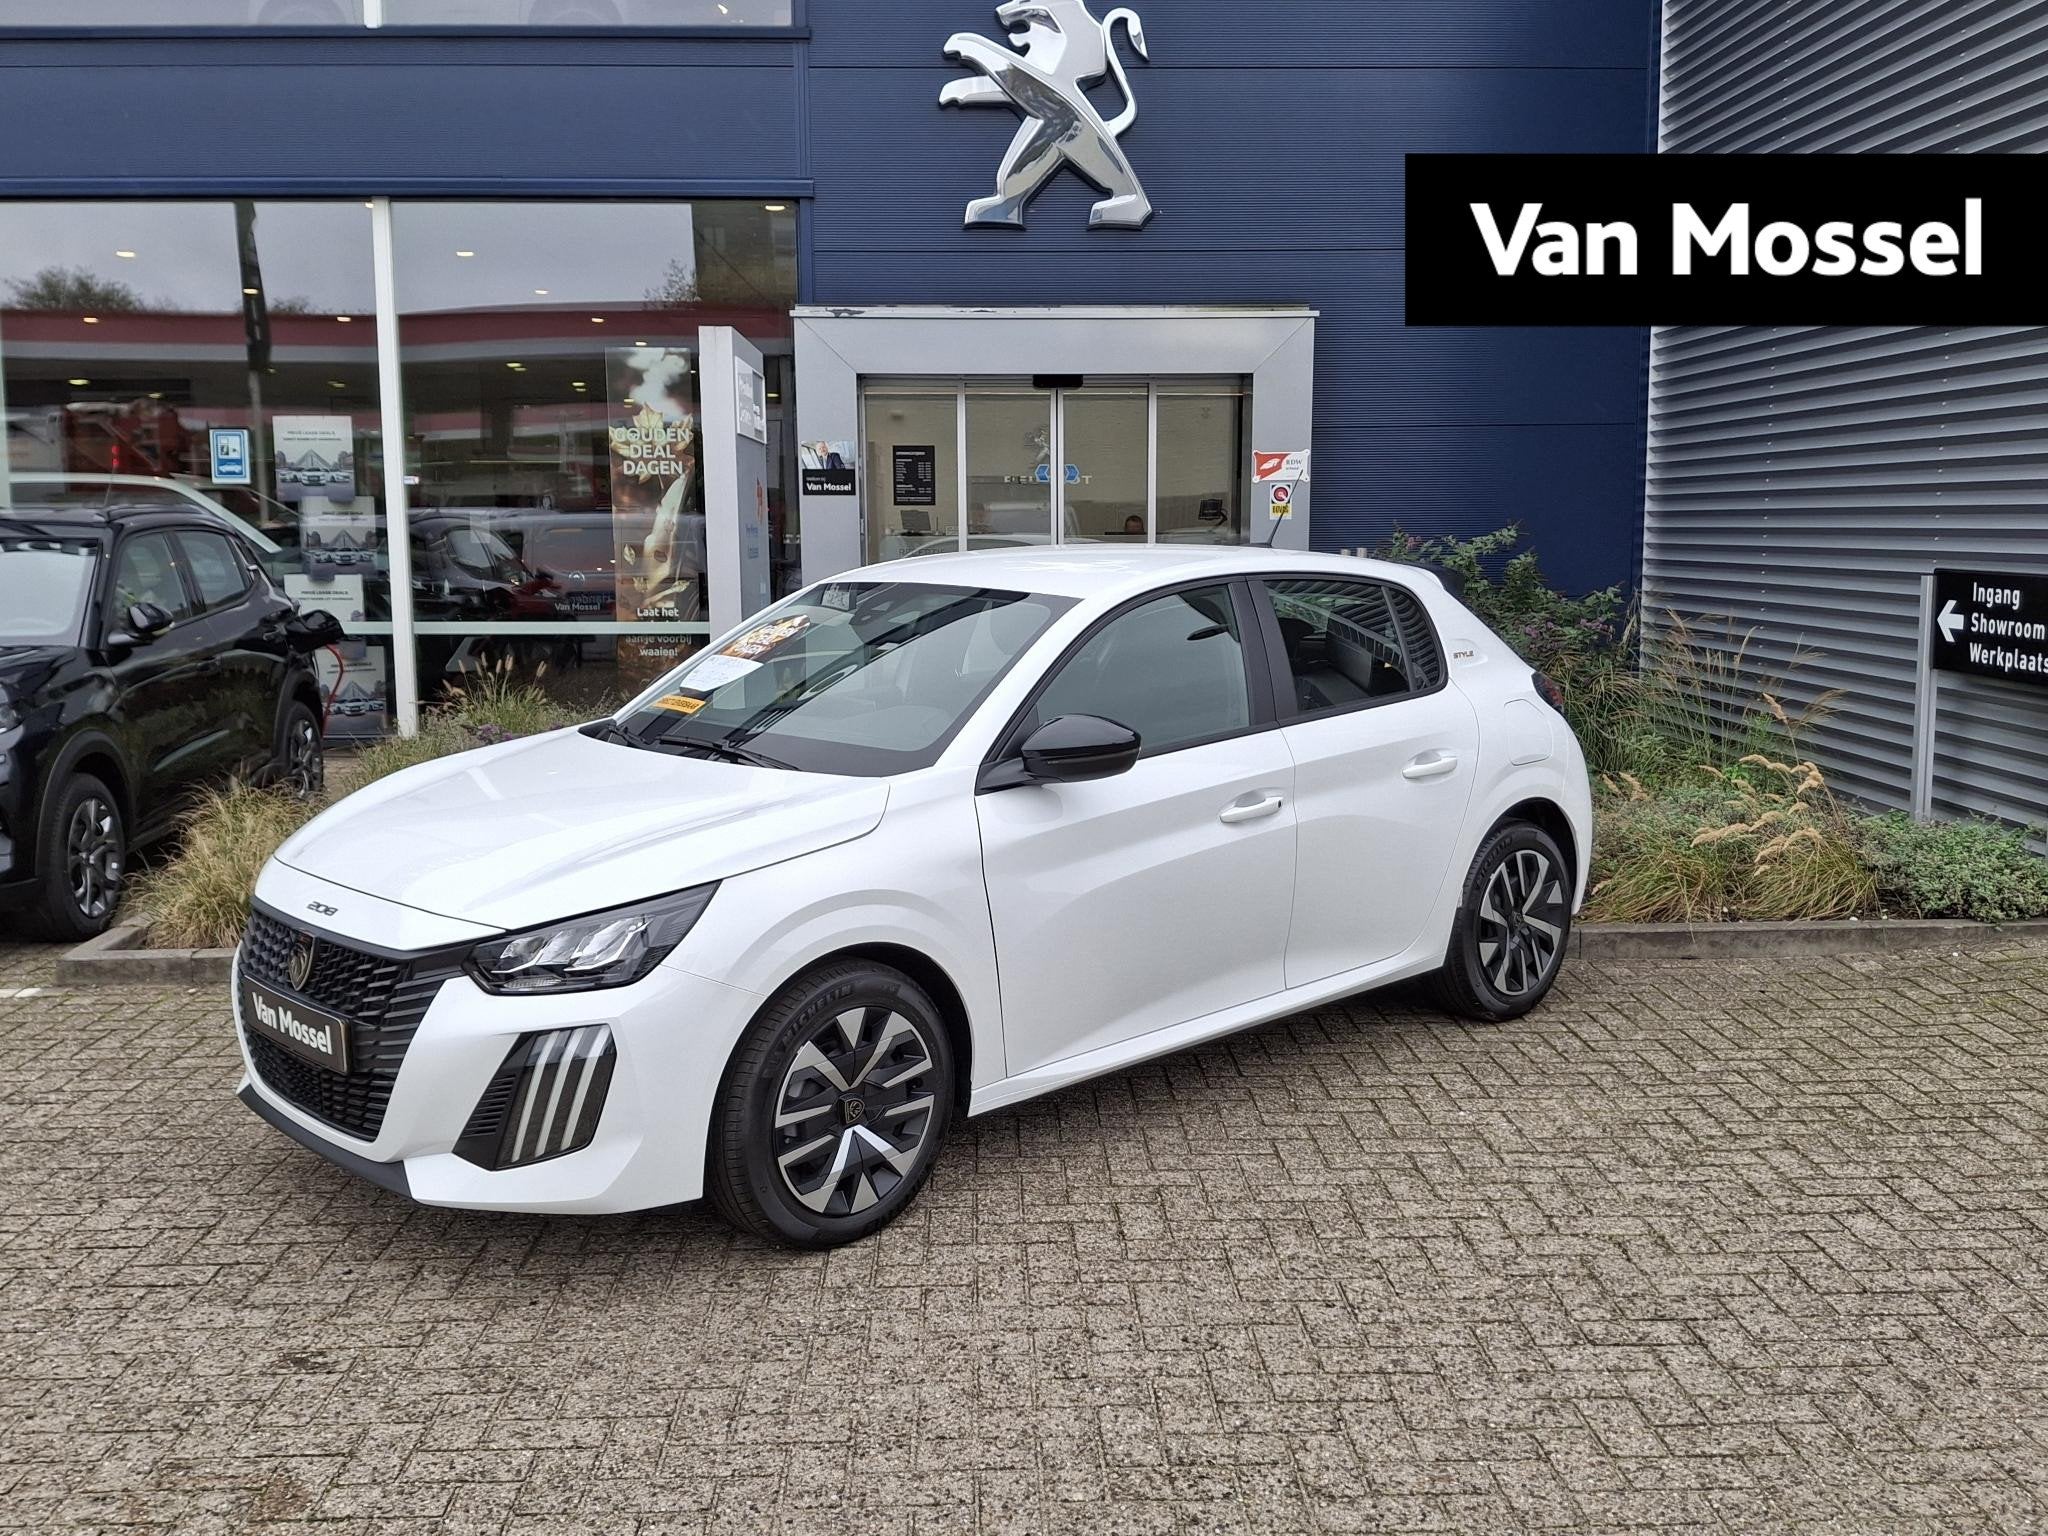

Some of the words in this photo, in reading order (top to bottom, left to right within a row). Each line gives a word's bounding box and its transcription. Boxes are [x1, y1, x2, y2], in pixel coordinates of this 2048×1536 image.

[613, 427, 689, 442] GOUDEN
[630, 444, 676, 458] DEAL
[623, 460, 683, 475] DAGEN
[806, 482, 822, 491] Van
[824, 482, 852, 491] Mossel
[1973, 582, 2021, 611] Ingang
[637, 608, 660, 617] Laat
[661, 607, 679, 617] het
[1971, 612, 2045, 640] Showroom
[657, 634, 692, 645] voorbij
[639, 647, 678, 656] waaien!
[1453, 650, 1474, 659] STYLE
[1969, 642, 2048, 674] Werkplaats
[307, 900, 339, 917] 208
[782, 984, 852, 1047] MICHELIN
[252, 992, 277, 1031] Van
[278, 1006, 333, 1055] Mossel
